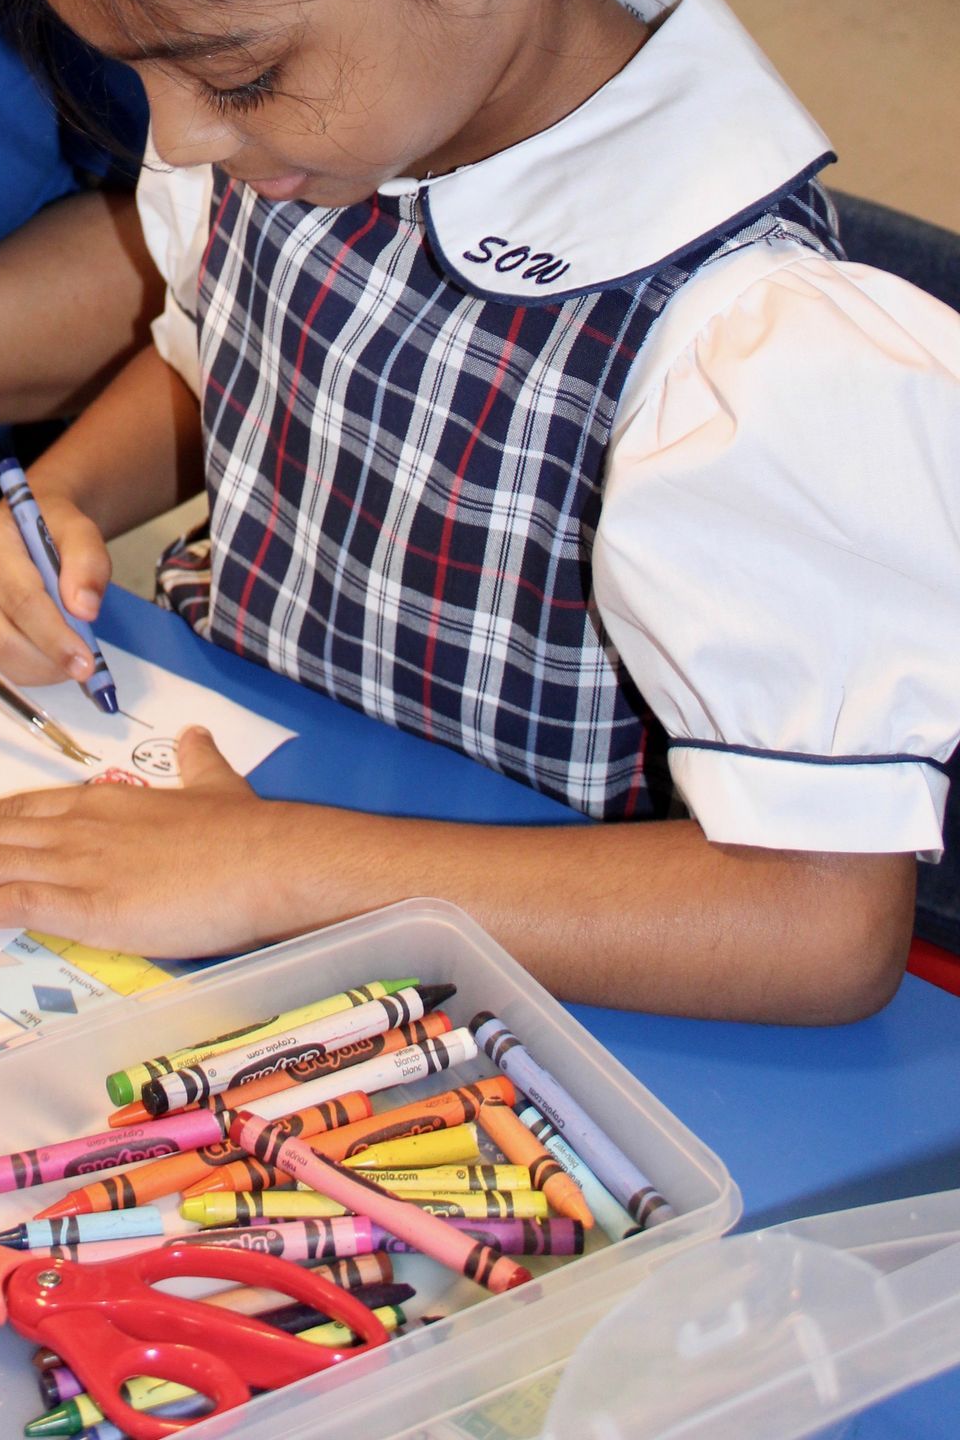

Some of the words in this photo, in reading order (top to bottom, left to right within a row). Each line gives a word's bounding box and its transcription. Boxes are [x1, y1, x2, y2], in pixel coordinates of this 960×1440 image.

[462, 236, 571, 284] SOW
[58, 965, 105, 999] rhombus
[20, 1008, 43, 1028] blue
[246, 1036, 298, 1060] Crayola.com
[290, 1035, 377, 1075] Crayola
[393, 1053, 421, 1068] blanco
[401, 1063, 423, 1078] blanc
[528, 1086, 566, 1130] Crayola.com
[86, 1128, 144, 1149] Crayola.com
